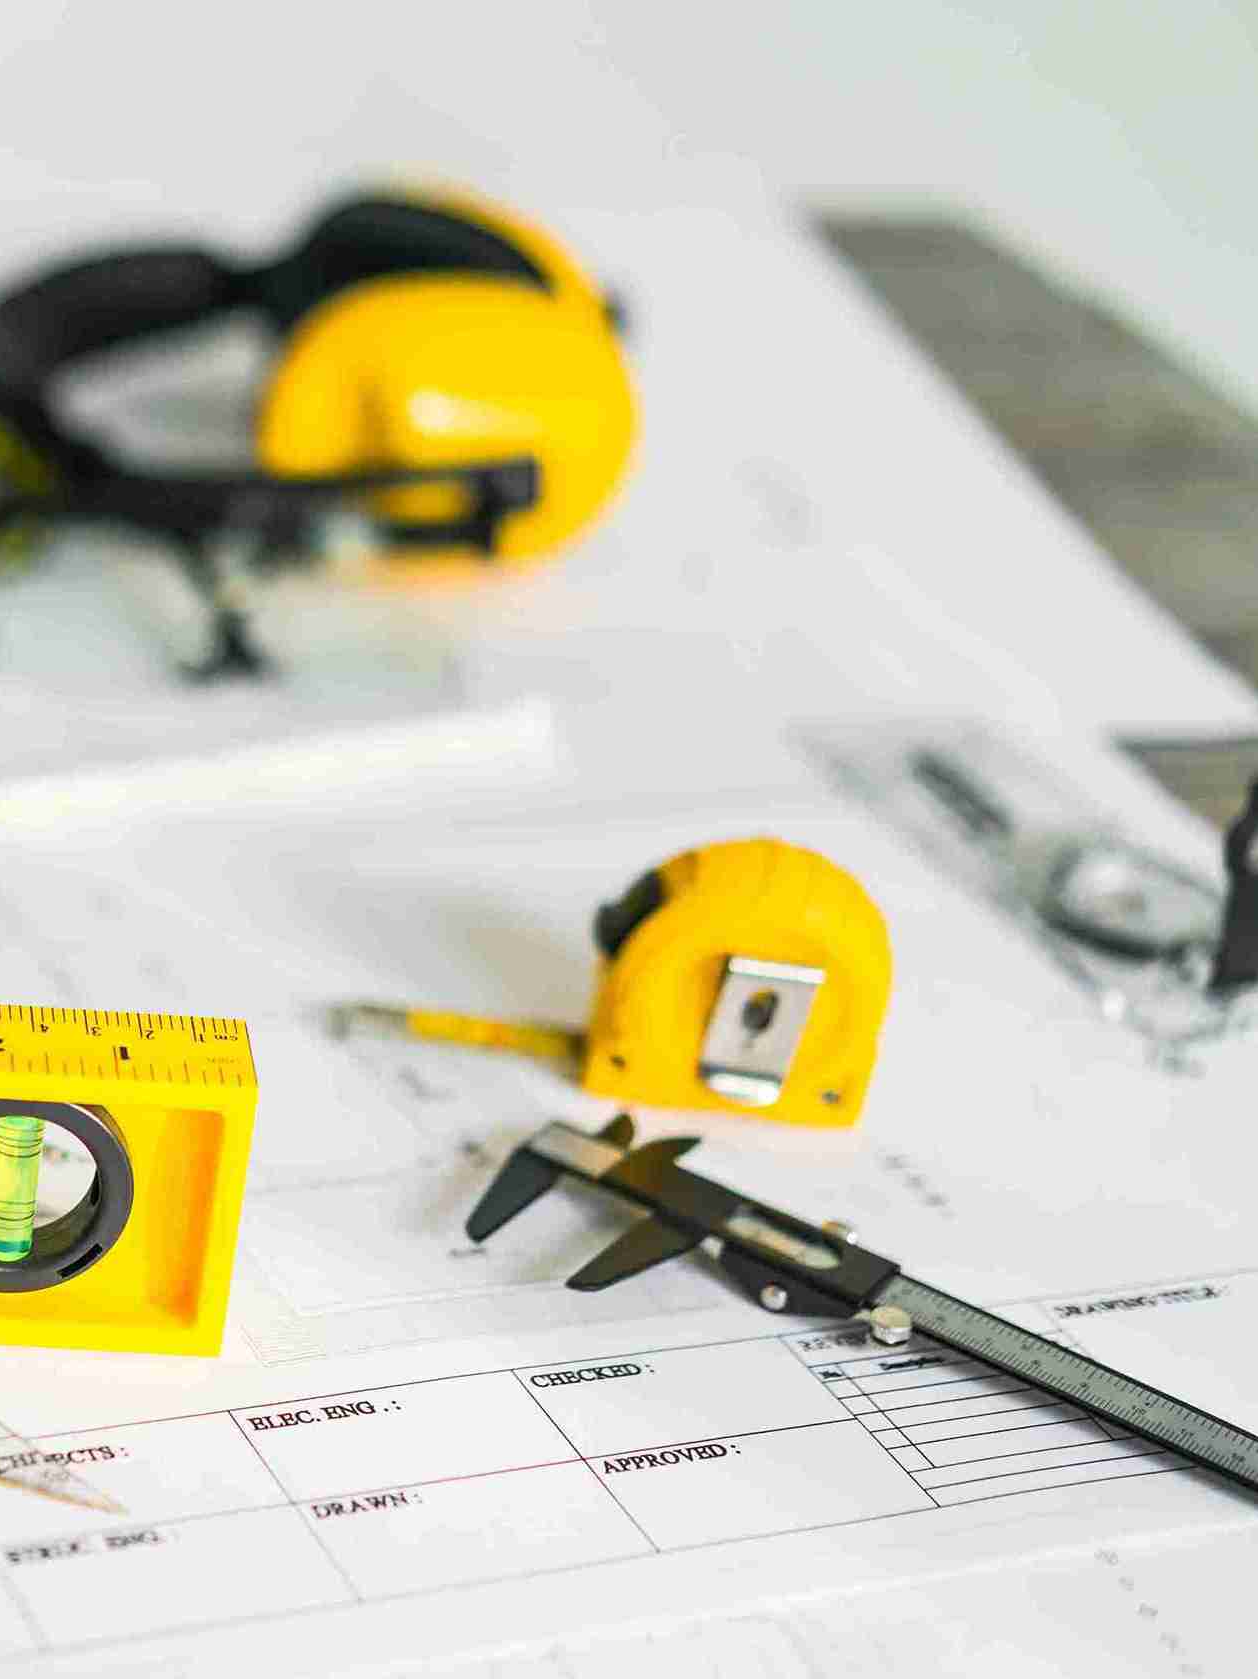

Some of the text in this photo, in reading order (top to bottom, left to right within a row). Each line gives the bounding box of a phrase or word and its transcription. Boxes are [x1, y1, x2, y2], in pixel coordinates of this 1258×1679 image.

[40, 1024, 50, 1034] 4
[91, 1026, 102, 1037] 3
[144, 1029, 156, 1040] 2
[119, 1046, 131, 1061] 1
[248, 1410, 322, 1431] ELEC.
